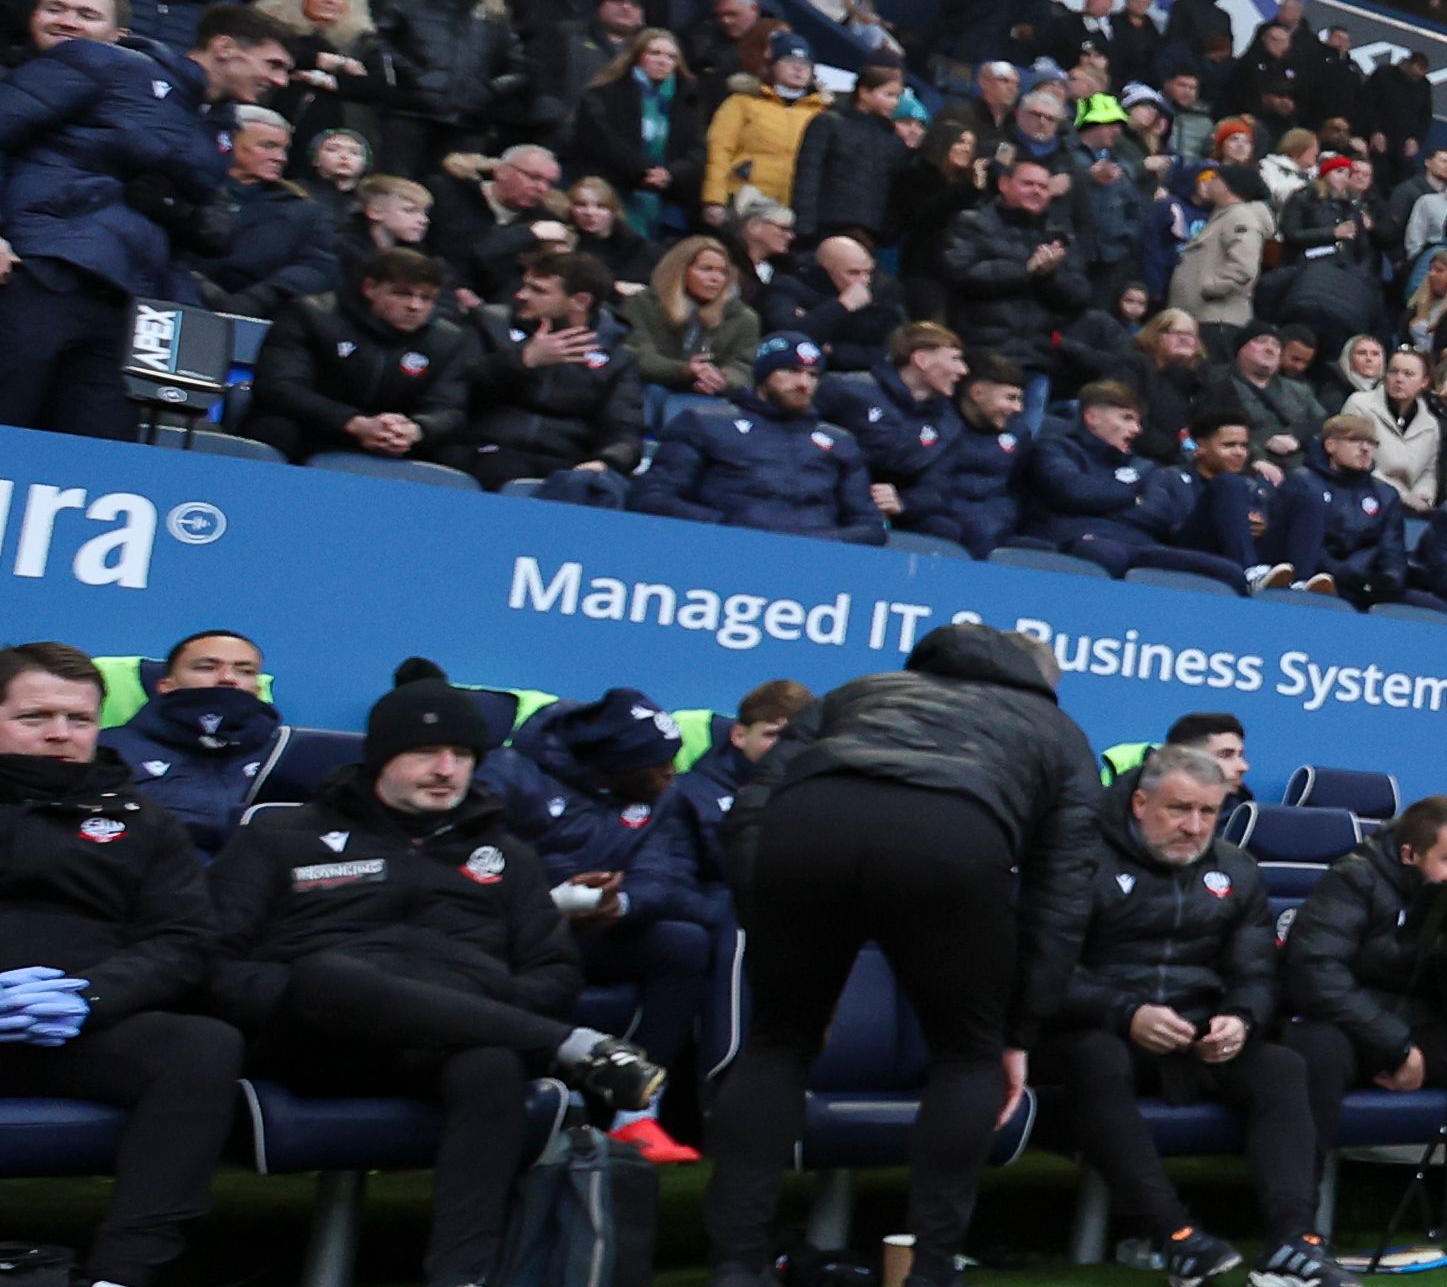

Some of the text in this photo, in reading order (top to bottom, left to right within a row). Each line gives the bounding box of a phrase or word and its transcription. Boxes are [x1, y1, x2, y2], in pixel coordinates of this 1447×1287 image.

[133, 304, 178, 372] APEX
[508, 556, 852, 650] Managed
[868, 600, 932, 654] IT
